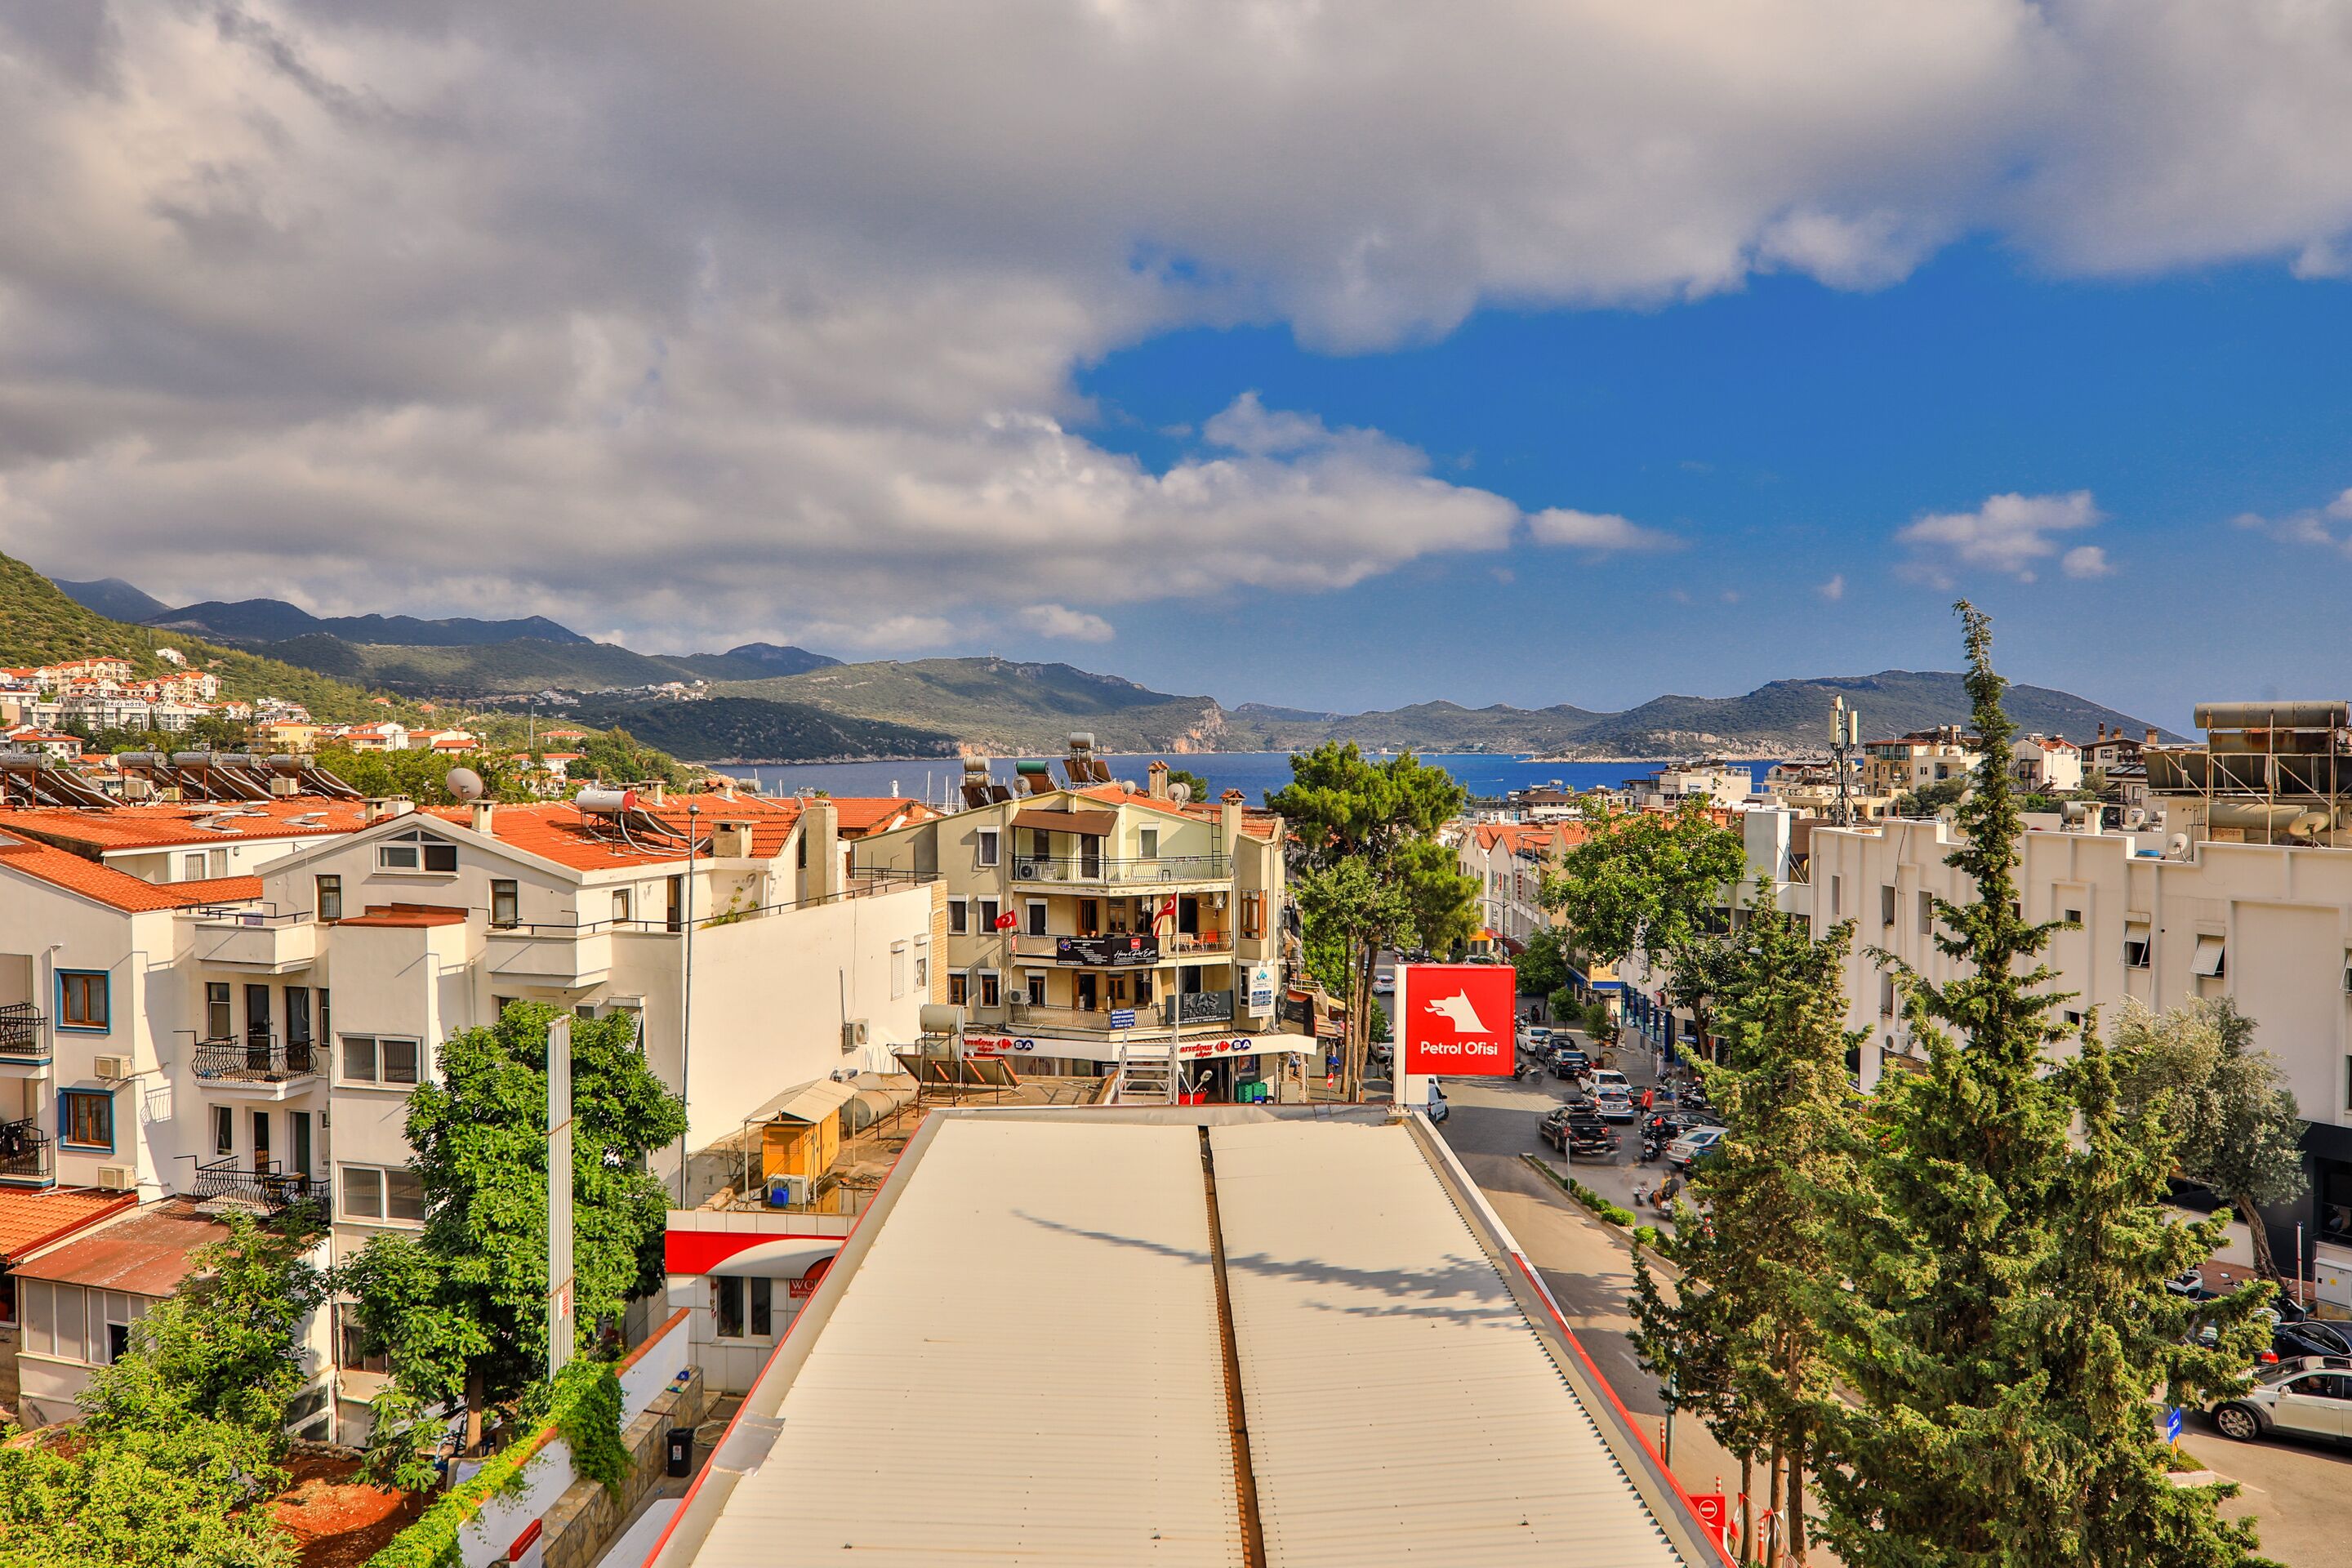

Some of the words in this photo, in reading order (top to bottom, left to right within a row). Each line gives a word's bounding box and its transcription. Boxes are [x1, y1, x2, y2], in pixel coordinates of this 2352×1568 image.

[964, 1038, 995, 1046] arrefour
[1179, 1044, 1214, 1053] arrefour
[1421, 1041, 1462, 1054] Petrol
[1465, 1041, 1498, 1055] Ofisi
[791, 1280, 814, 1290] WC
